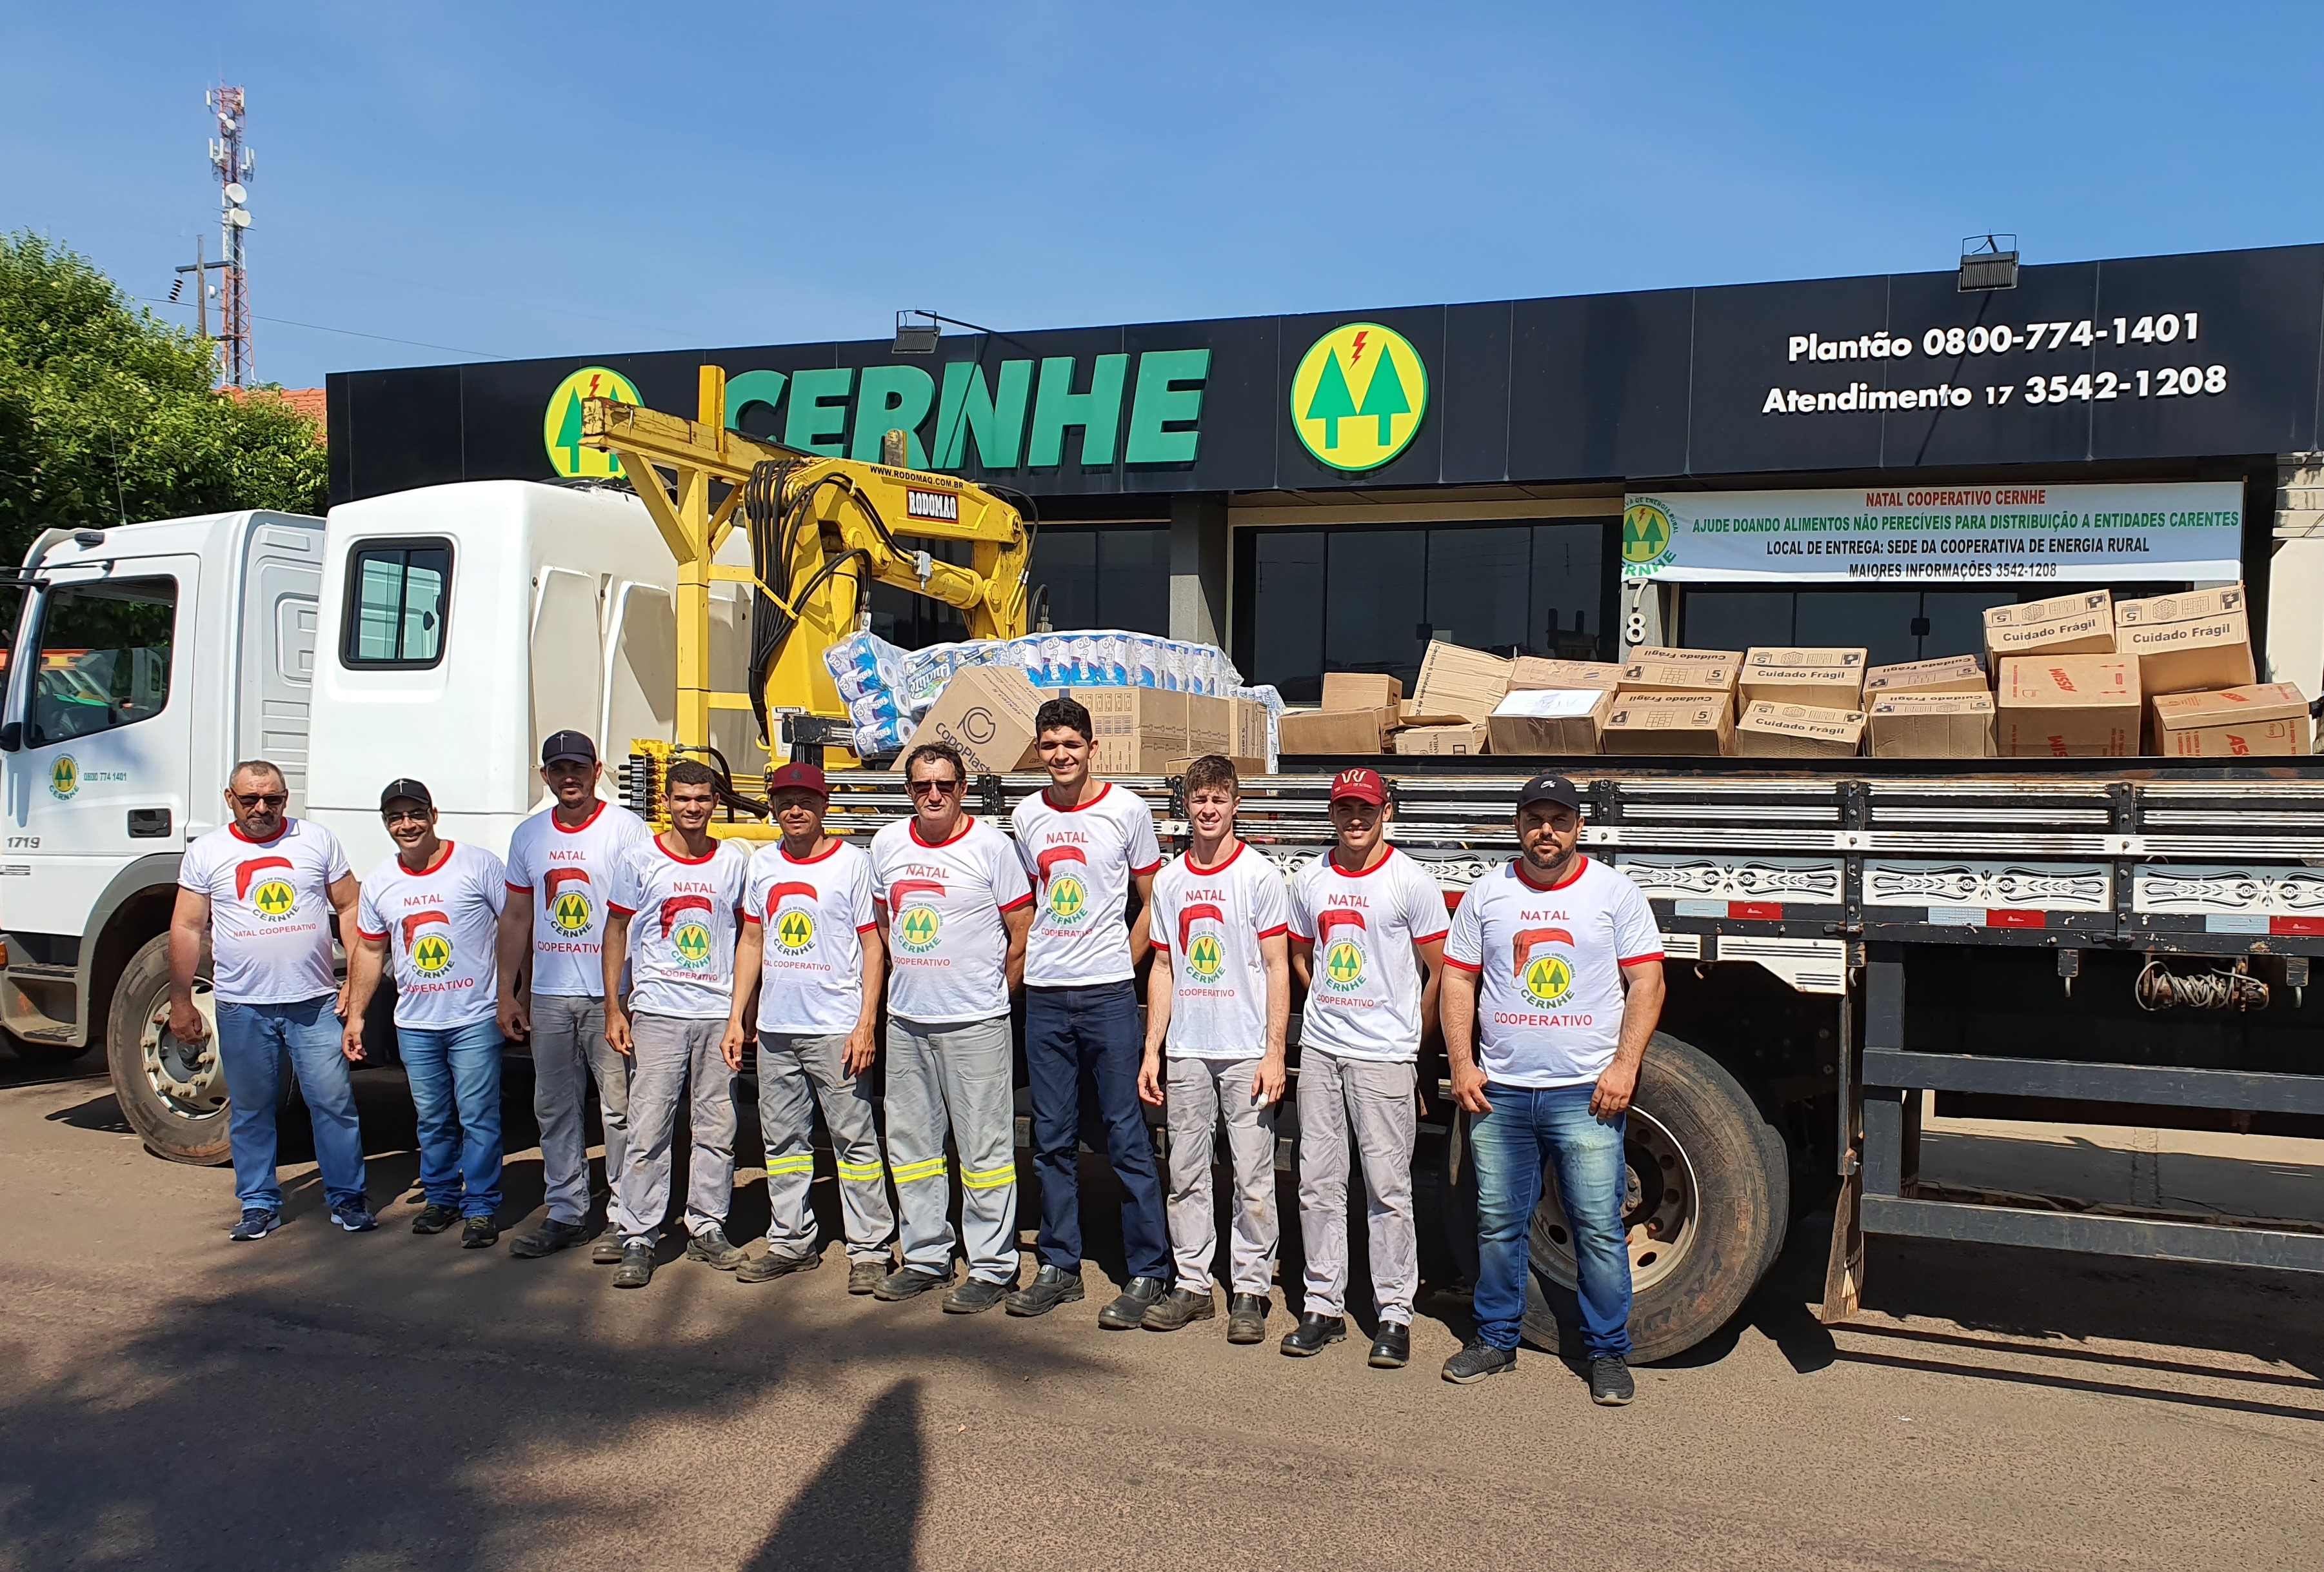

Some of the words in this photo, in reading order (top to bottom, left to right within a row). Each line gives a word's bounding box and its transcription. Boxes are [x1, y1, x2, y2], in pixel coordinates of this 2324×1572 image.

[1788, 330, 1912, 362] Plantão
[1922, 312, 2200, 357] 0800-774-1401
[1762, 383, 1972, 414] Atendimento
[1985, 385, 2014, 406] 17
[2024, 364, 2228, 405] 3542-1208
[724, 349, 1211, 470] CERNHE
[869, 465, 964, 490] WWW.RODOMAQ.COM.BR
[908, 491, 957, 519] RODOMAQ
[1865, 492, 1903, 507] NATAL
[1907, 490, 1992, 506] COOPERATIVO
[1996, 489, 2046, 505] CERNHE
[1668, 513, 1679, 534] RURAL
[1693, 517, 1730, 533] AJUDE
[1733, 516, 1781, 532] DOANDO
[1783, 515, 1850, 532] ALIMENTOS
[1853, 512, 1878, 531] NÃO
[1882, 512, 1951, 531] PERECÍVEIS
[1954, 514, 1987, 530] PARA
[1990, 510, 2078, 533] DISTRIBUIÇÃO
[2081, 513, 2091, 528] A
[2094, 512, 2166, 528] ENTIDADES
[2169, 511, 2239, 527] CARENTES
[1767, 541, 1804, 555] LOCAL
[1807, 540, 1823, 555] DE
[1825, 539, 1884, 555] ENTREGA:
[1887, 539, 1918, 554] SEDE
[1921, 539, 1937, 553] DA
[1940, 538, 2025, 554] COOPERATIVA
[2029, 538, 2045, 553] DE
[2049, 537, 2104, 553] ENERGIA
[2107, 537, 2150, 552] RURAL
[1622, 550, 1677, 576] ERNHE
[1849, 563, 1902, 578] MAIORES
[1905, 561, 1992, 580] INFORMAÇÕES
[1996, 562, 2057, 577] 3542-1208
[2003, 626, 2056, 642] Cuidado
[2060, 619, 2096, 635] Frágil
[2132, 628, 2187, 644] Cuidado
[2192, 623, 2231, 640] Frágil
[1644, 650, 1676, 659] Frágil
[1921, 658, 1971, 668] Cuidado
[1711, 670, 1722, 678] 5
[1810, 671, 1845, 680] Frágil
[2048, 668, 2077, 692] ASSIM
[1756, 718, 1805, 731] Cuidado
[1809, 726, 1845, 735] Frágil
[100, 772, 111, 781] 774
[113, 772, 127, 781] 1401
[49, 784, 79, 801] CERNHE
[7, 837, 41, 849] 1719
[1046, 831, 1089, 844] NATAL
[549, 850, 586, 861] NATAL
[906, 864, 950, 879] NATAL
[673, 881, 717, 894] NATAL
[1186, 890, 1226, 902] NATAL
[403, 893, 444, 907] NATAL
[1327, 894, 1369, 908] NATAL
[252, 905, 300, 922] CERNHE
[1046, 907, 1088, 925] CERNHE
[1520, 910, 1570, 920] NATAL
[233, 930, 257, 938] NATAL
[259, 923, 317, 935] COOPERATIVO
[550, 921, 593, 938] CERNHE
[537, 940, 601, 953] COOPERATIV
[774, 938, 816, 956] CERNHE
[898, 935, 942, 953] CERNHE
[773, 960, 831, 971] COOPERATIVO
[894, 955, 951, 966] COOPERATIVO
[412, 960, 455, 979] CERNHE
[660, 969, 718, 981] COOPERATIVO
[1186, 966, 1226, 984] CERNHE
[1178, 988, 1235, 997] COOPERATIVO
[1317, 993, 1375, 1007] COOPERATIVO
[1520, 989, 1575, 1010] CERNHE
[1494, 1011, 1593, 1026] COOPERATIVO
